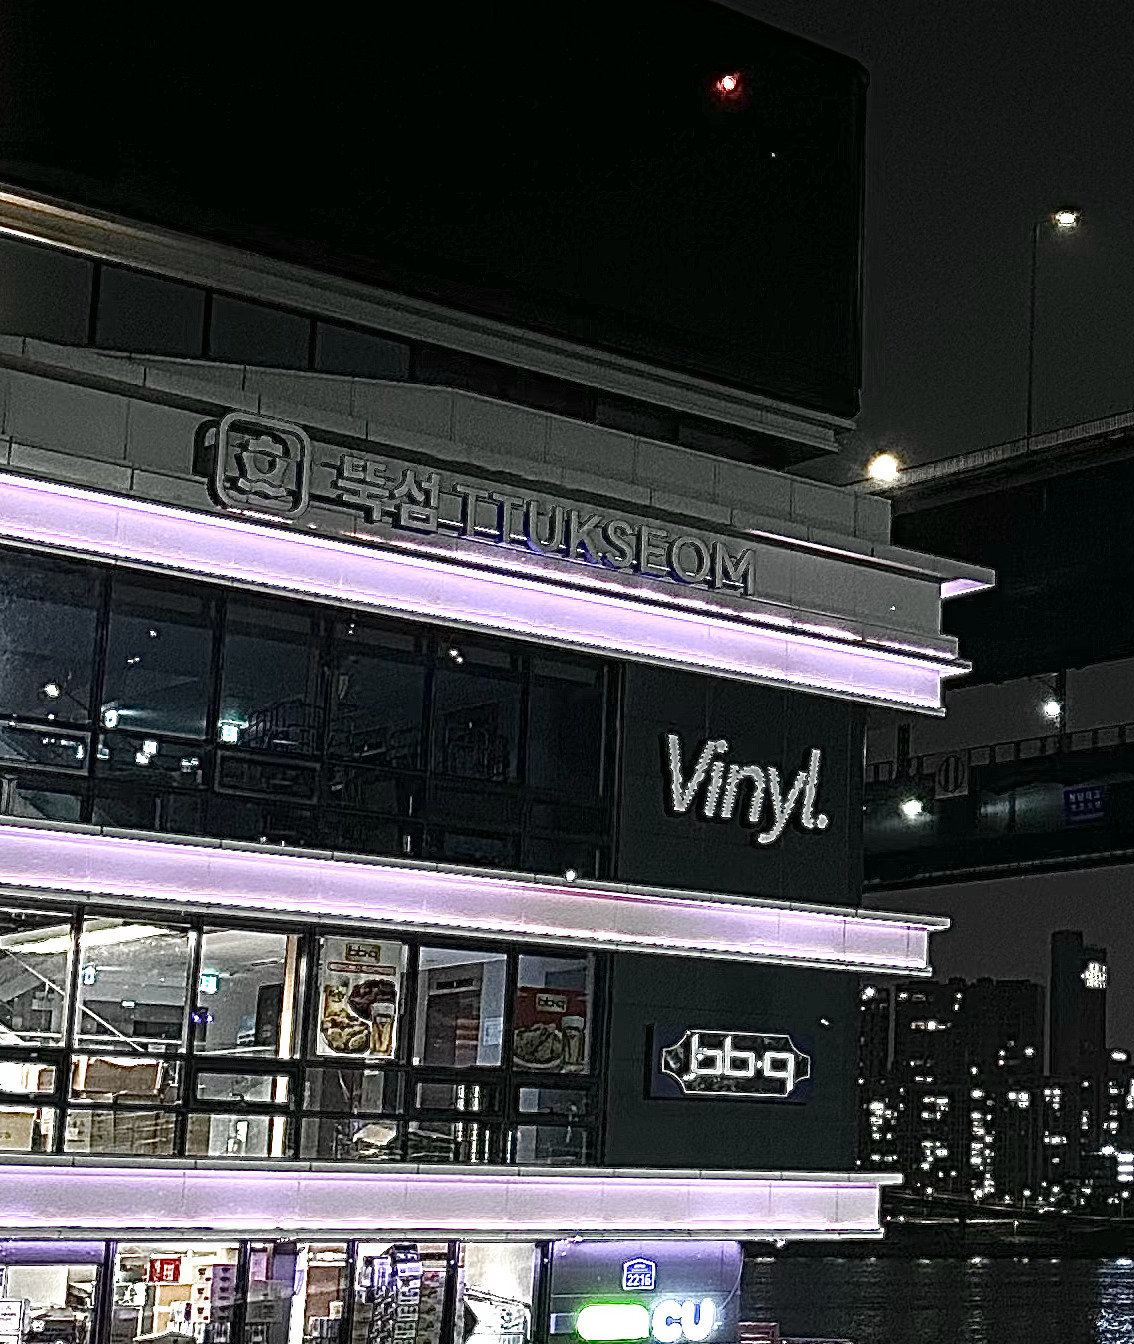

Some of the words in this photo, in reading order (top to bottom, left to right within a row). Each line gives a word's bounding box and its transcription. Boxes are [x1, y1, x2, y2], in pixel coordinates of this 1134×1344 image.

[336, 455, 440, 532] 뚝섬
[452, 483, 757, 595] TTUKSEOM
[626, 1273, 653, 1287] 2216
[651, 1298, 715, 1343] CU
